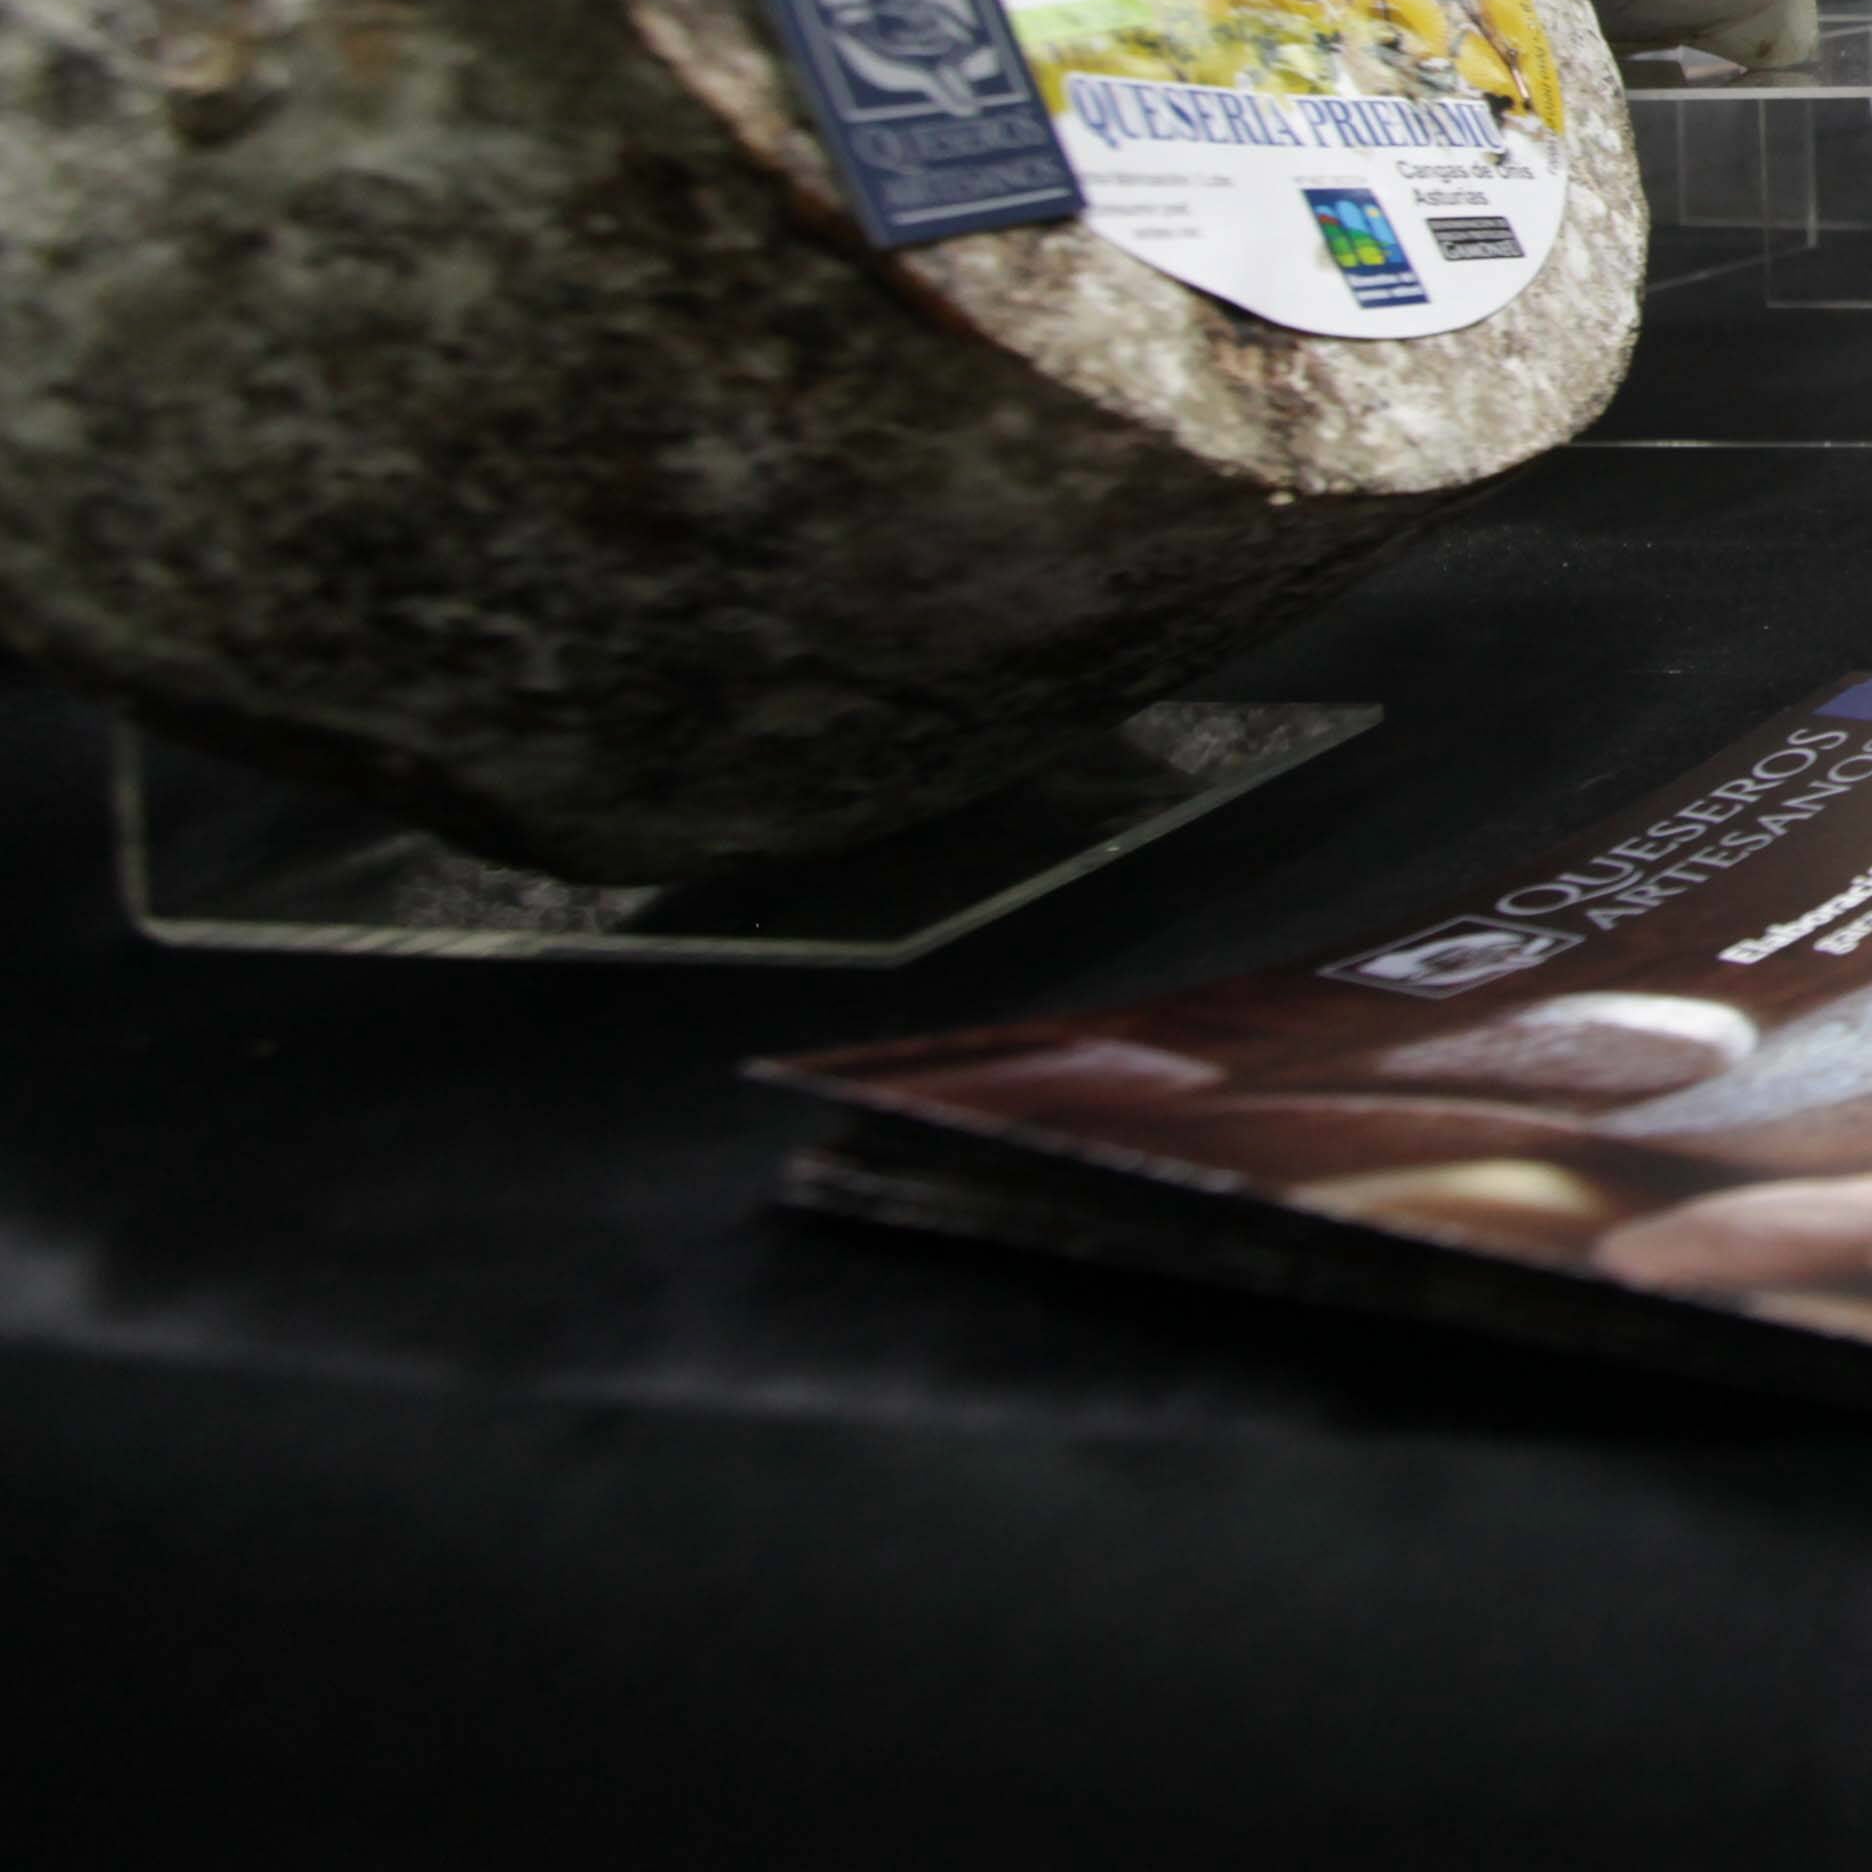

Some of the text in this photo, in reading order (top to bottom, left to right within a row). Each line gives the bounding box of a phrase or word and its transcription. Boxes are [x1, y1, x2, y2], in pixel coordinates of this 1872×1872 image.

[1396, 160, 1469, 184] Cangas
[1471, 162, 1494, 179] de
[1413, 188, 1490, 206] Asturias
[1495, 728, 1849, 917] QUESEROS
